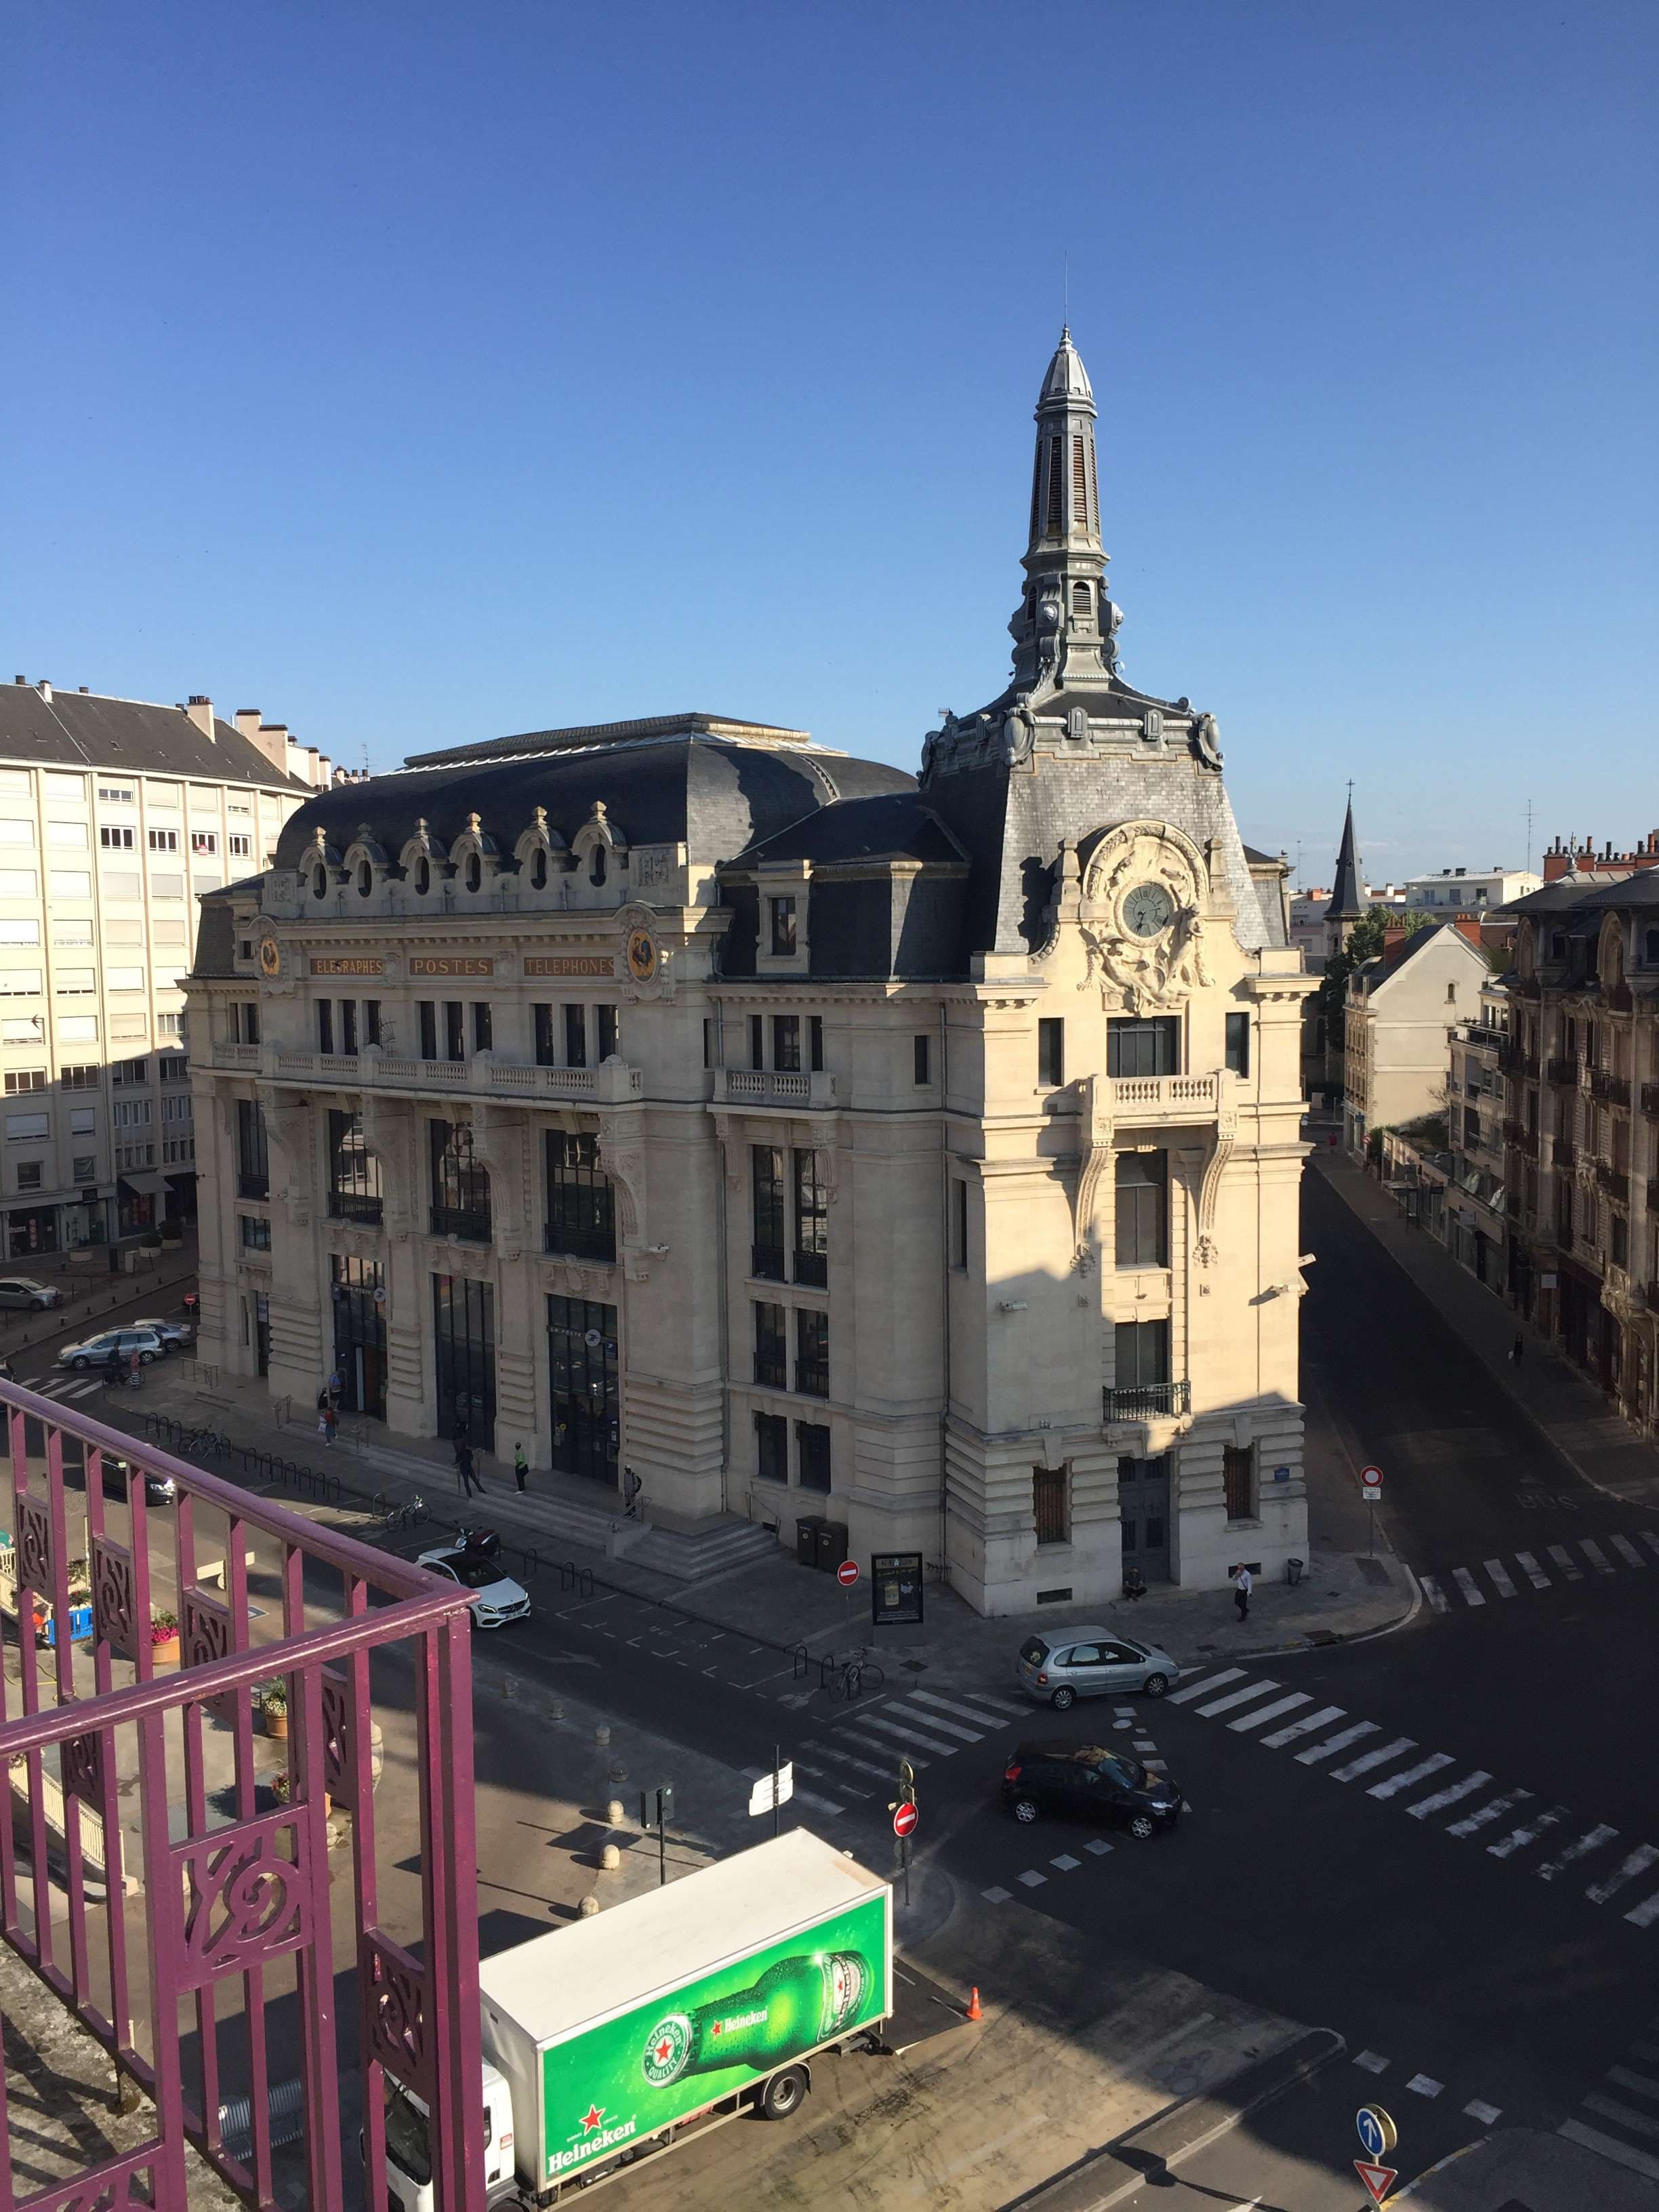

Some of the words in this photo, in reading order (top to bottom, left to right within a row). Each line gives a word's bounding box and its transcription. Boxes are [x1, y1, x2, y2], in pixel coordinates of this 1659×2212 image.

[415, 959, 489, 974] POSTES
[526, 959, 615, 975] TELEPHONES
[1515, 1493, 1579, 1511] BUS
[724, 2009, 768, 2034] Heineken
[645, 2022, 682, 2055] Heineken
[648, 2057, 678, 2080] QUALITY
[548, 2119, 636, 2175] Heineken
